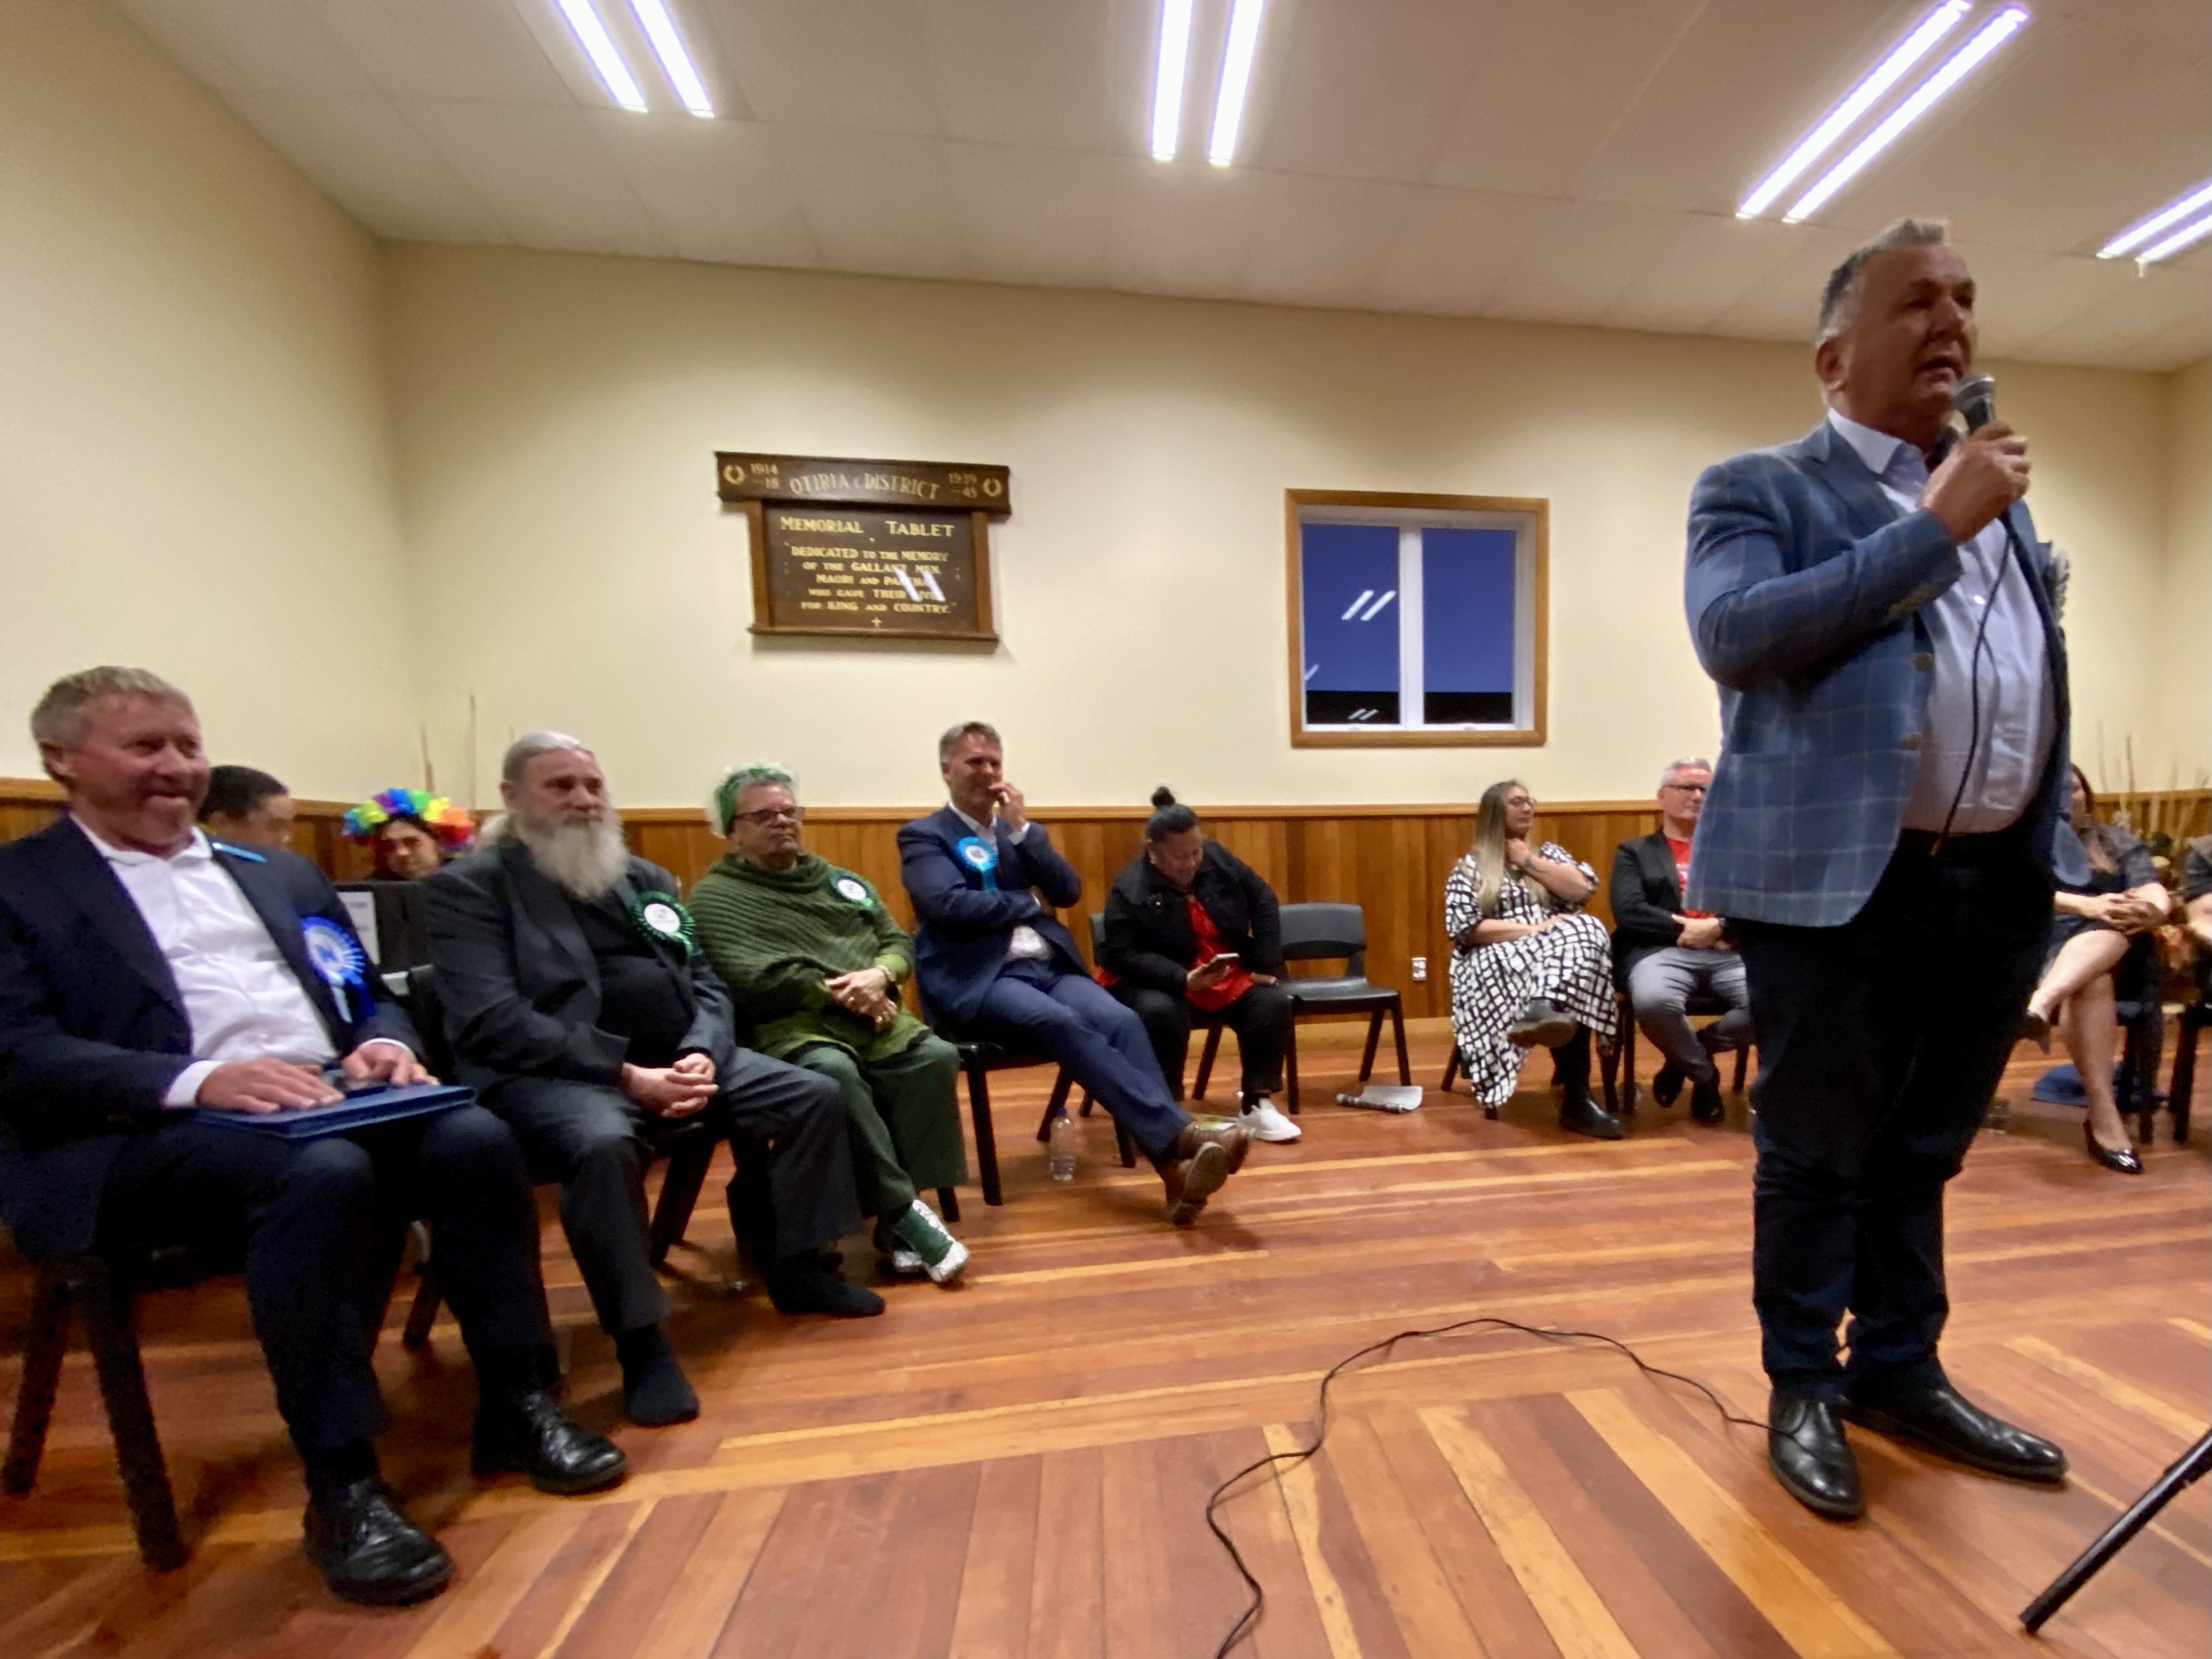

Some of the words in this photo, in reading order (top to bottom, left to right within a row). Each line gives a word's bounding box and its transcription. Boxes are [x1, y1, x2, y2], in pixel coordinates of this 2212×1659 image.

[750, 462, 779, 475] 1914
[789, 473, 850, 495] OTIRIA
[864, 473, 940, 500] DISTRICT
[780, 517, 864, 533] MEMORIAL
[885, 520, 956, 537] TABLET
[791, 546, 859, 559] DEDICATED
[861, 551, 877, 559] TO
[879, 551, 899, 561] THE
[901, 551, 949, 562] MEMORY
[802, 561, 818, 570] OF
[822, 562, 845, 571] THE
[816, 573, 855, 584] MAORI
[836, 589, 864, 597] GAVE
[872, 589, 907, 599] THEIR
[827, 601, 859, 611] KING
